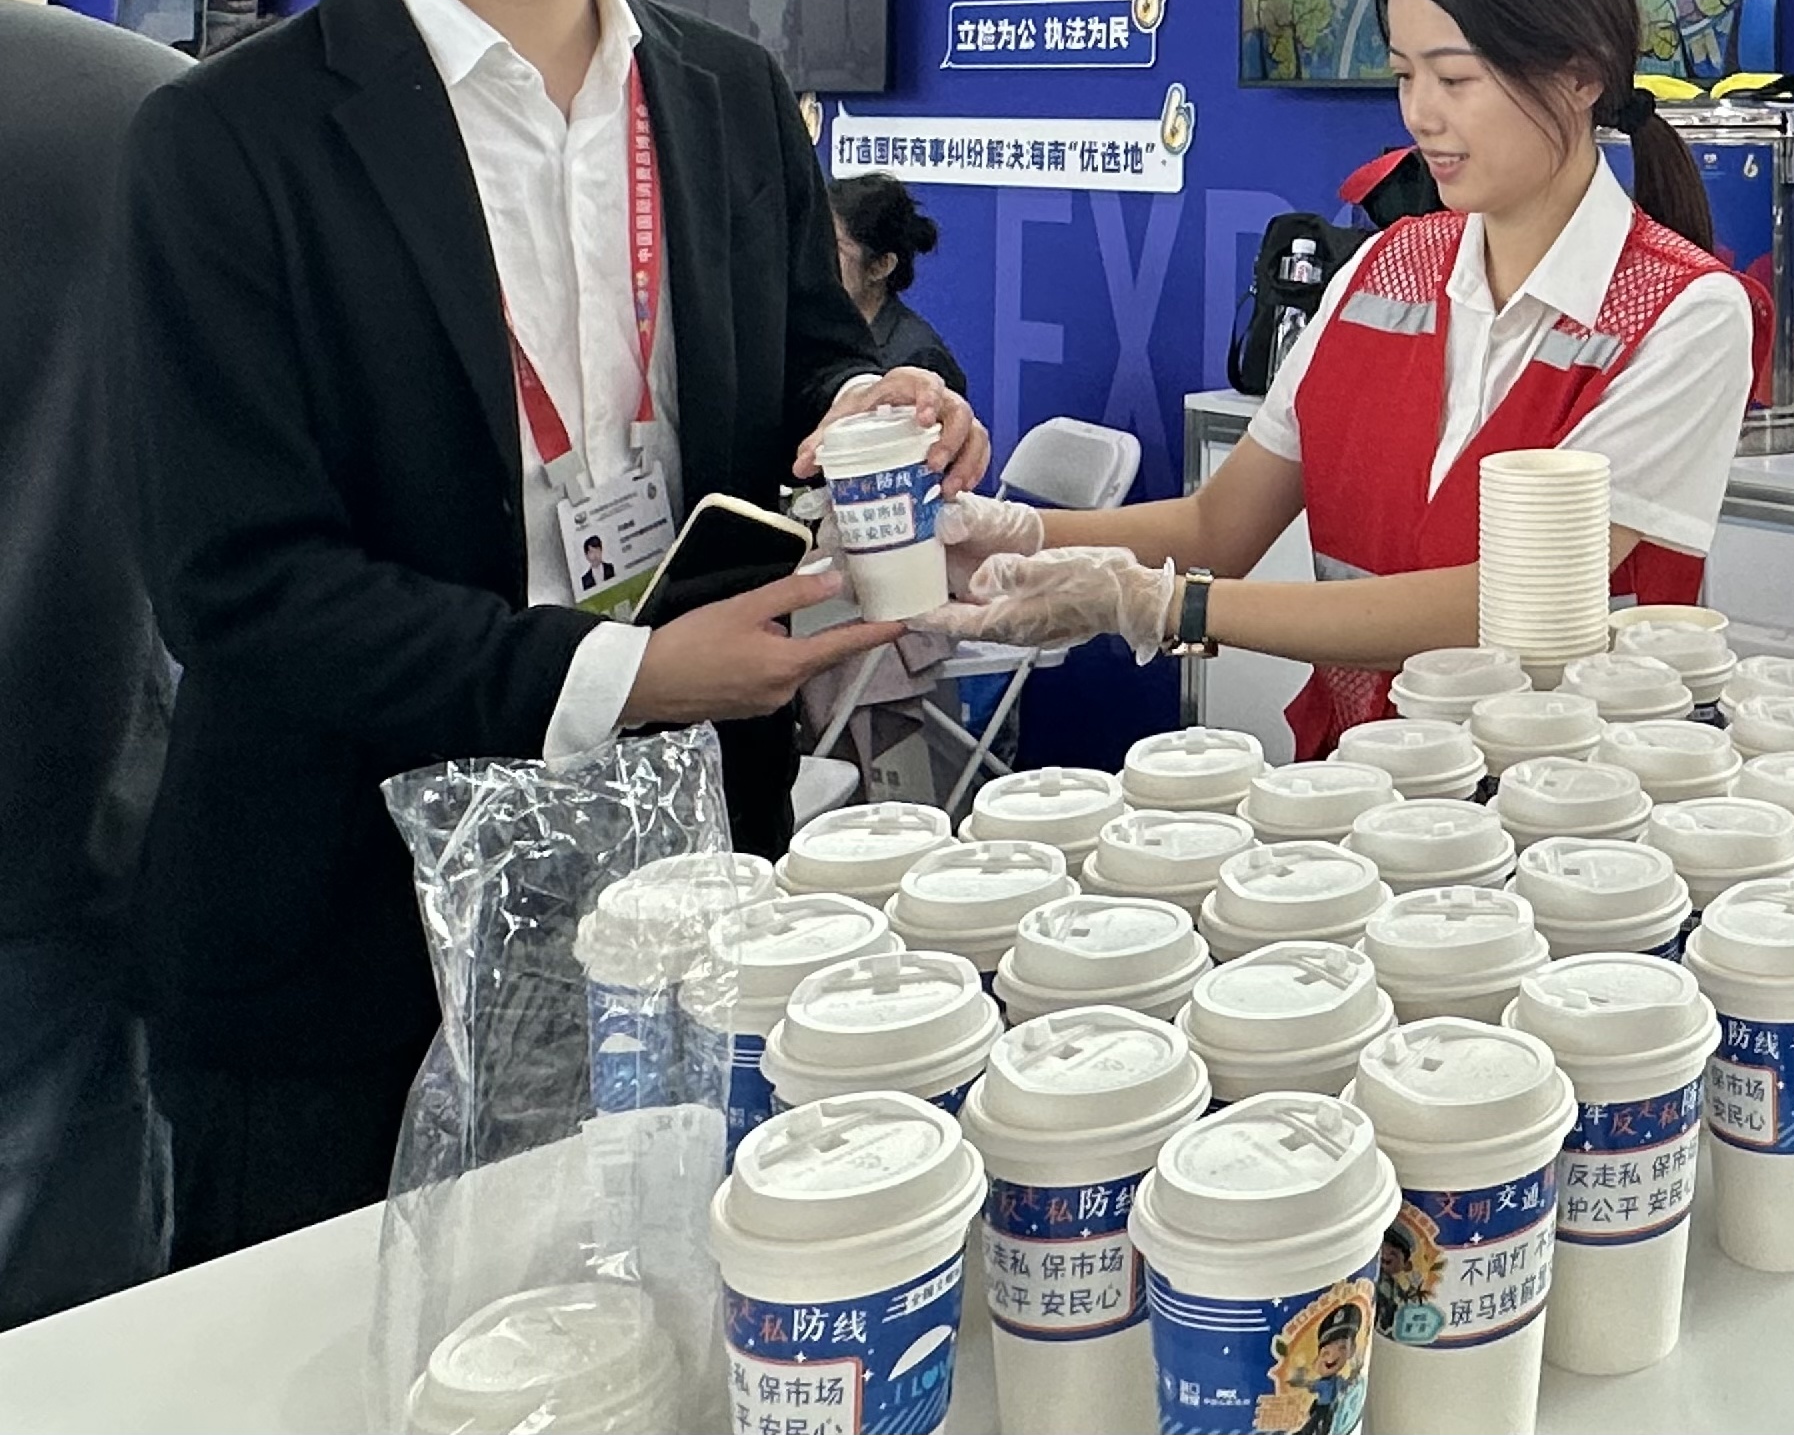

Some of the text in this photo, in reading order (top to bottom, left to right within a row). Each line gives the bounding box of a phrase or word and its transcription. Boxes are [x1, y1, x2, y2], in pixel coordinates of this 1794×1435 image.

[956, 15, 1130, 52] 立检为公 执法为民
[837, 134, 1156, 176] 打造国际商事纠纷解决海南“优选地”
[1712, 1097, 1765, 1132] 安民心
[1567, 1162, 1642, 1189] 反走私
[1567, 1195, 1640, 1223] 护公平
[1041, 1246, 1125, 1281] 保市场
[1460, 1242, 1530, 1287] 不闯灯
[1041, 1283, 1122, 1317] 安民心
[757, 1372, 845, 1408] 保市场
